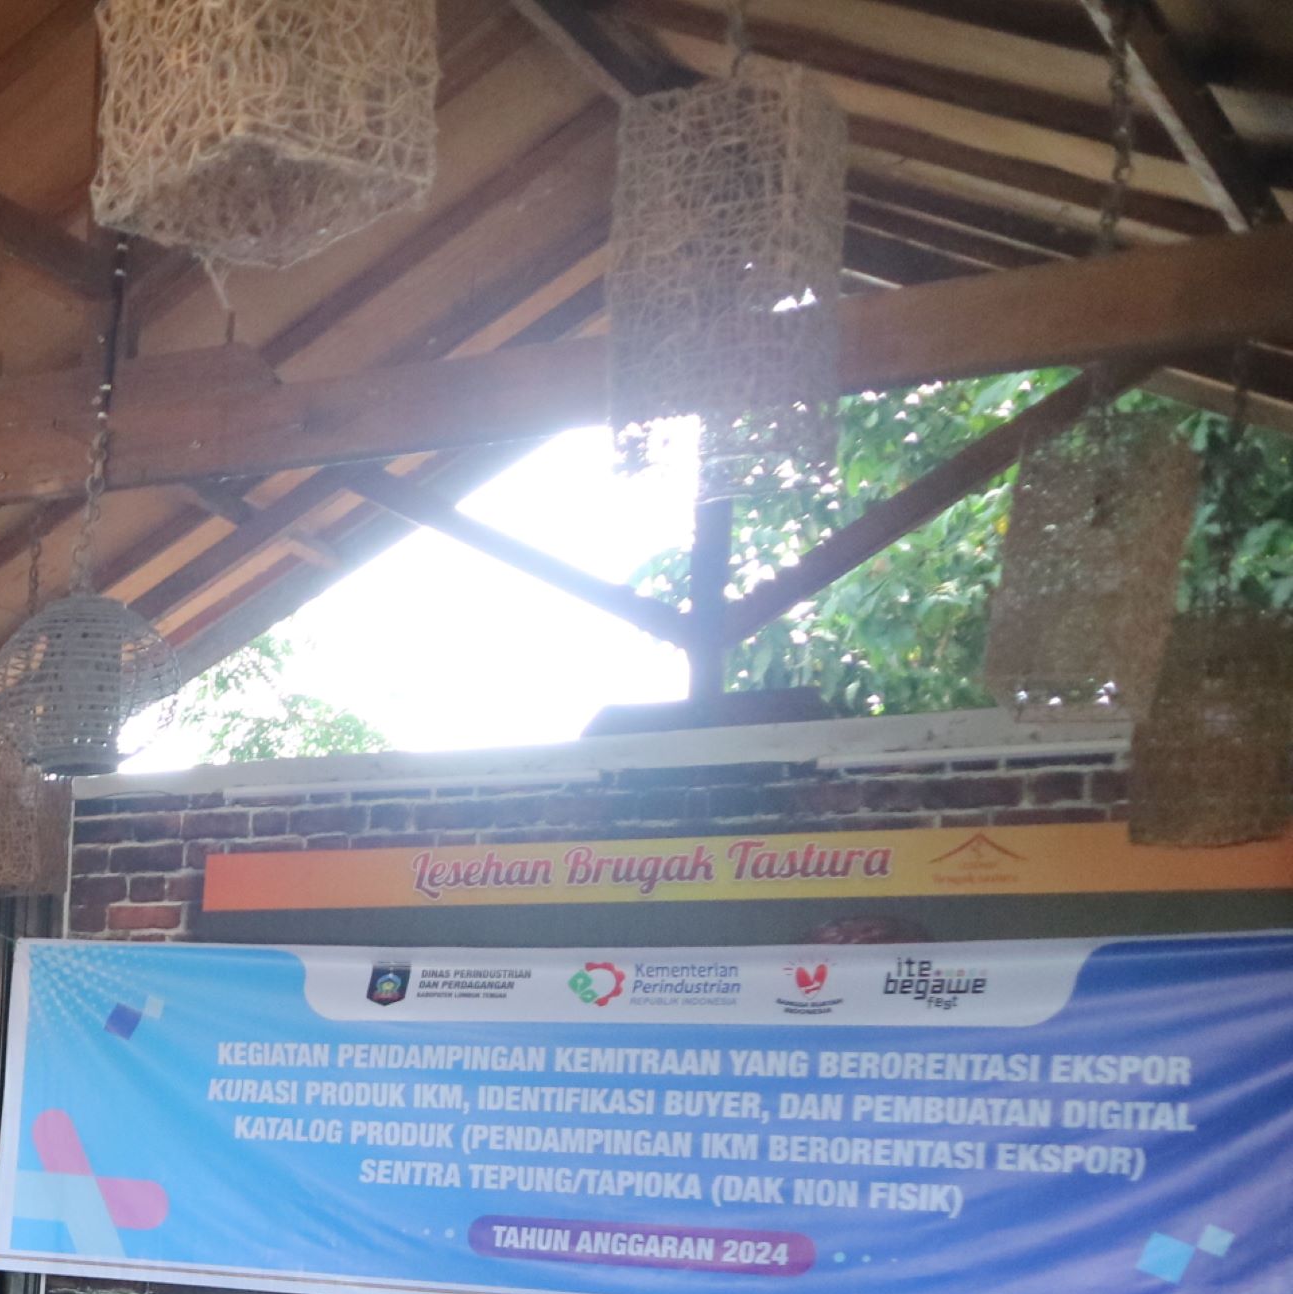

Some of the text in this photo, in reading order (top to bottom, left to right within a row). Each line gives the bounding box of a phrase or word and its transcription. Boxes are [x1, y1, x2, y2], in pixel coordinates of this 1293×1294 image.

[413, 839, 893, 899] Lesehan Brugak Tastura
[421, 969, 532, 979] DINAS PERINDUSTRIAN
[634, 962, 739, 978] Kementerian
[896, 957, 932, 977] ite
[418, 981, 439, 990] DAN
[632, 979, 742, 993] Perindustrian
[883, 972, 987, 1000] begawe
[217, 1041, 1192, 1086] KEGIATAN PENDAMPINGAN KEMITRAAN YANG BERORENTASI EKSPOR
[207, 1078, 1197, 1132] KURASI PRODUK IKM, IDENTIFIKASI BUYER, DAN PEMBUATAN DIGITAL
[233, 1115, 1147, 1182] KATALOG PRODUK (PENDAMPINGAN IKM BERORENTASI EKSPOR)
[358, 1158, 966, 1219] SENTRA TEPUNG/TAPIOKA (DAK NON FISIK)
[493, 1225, 790, 1266] TAHUN ANGGARAN 2024
